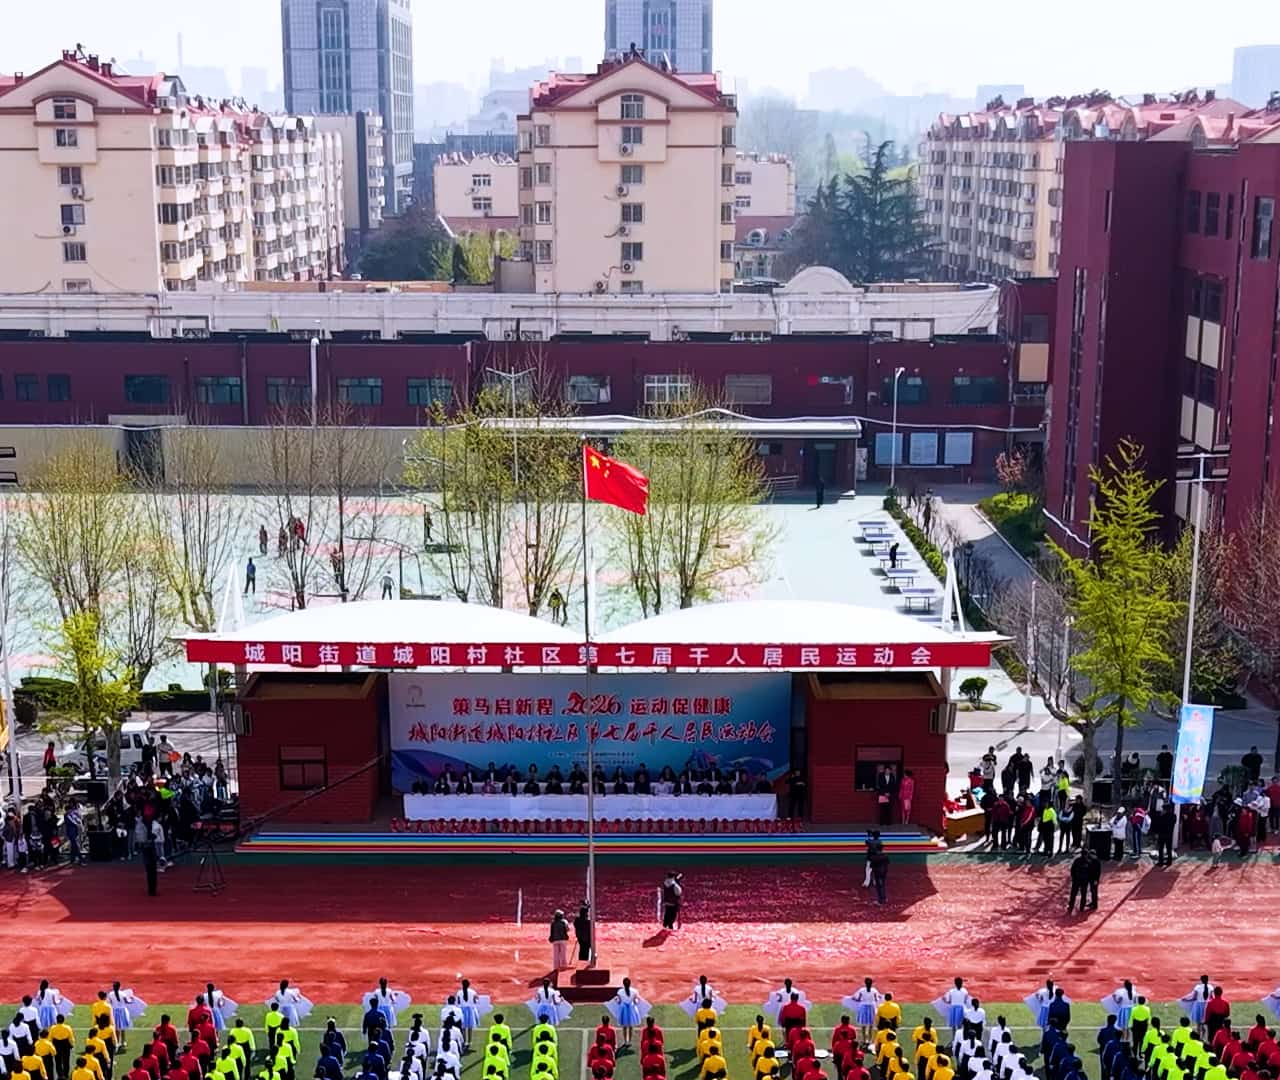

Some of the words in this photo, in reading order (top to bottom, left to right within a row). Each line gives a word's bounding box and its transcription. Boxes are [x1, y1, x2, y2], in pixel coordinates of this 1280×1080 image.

[244, 643, 932, 665] 城阳街道城阳村社区第七届千人居民运动会
[452, 697, 553, 716] 策马启新程
[561, 692, 622, 716] 2026
[629, 697, 733, 716] 运动促健康
